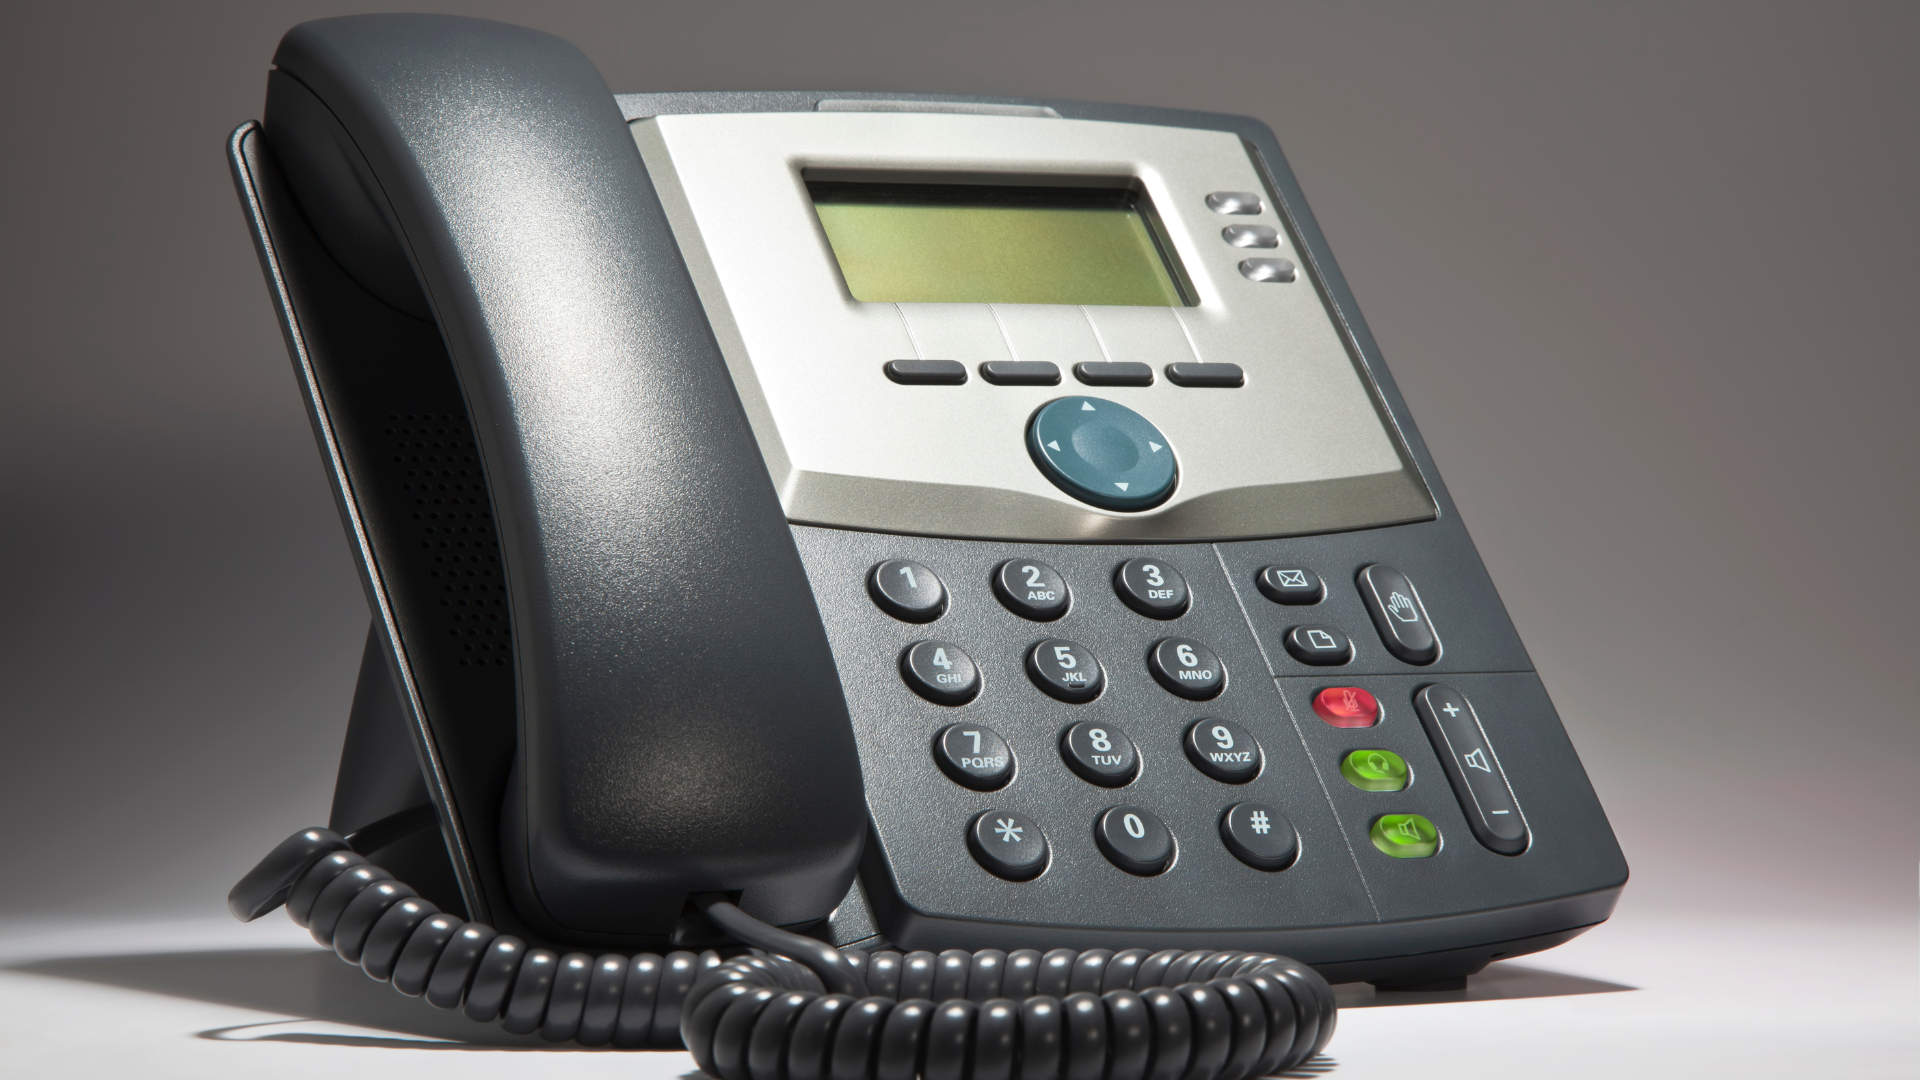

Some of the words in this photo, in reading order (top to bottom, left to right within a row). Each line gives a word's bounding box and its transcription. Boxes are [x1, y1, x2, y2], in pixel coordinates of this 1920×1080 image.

[900, 567, 919, 589] 1
[1022, 566, 1046, 588] 2
[1143, 565, 1165, 587] 3
[1027, 589, 1057, 602] ABC
[1147, 589, 1174, 599] DEF
[933, 648, 954, 670] 4
[1054, 647, 1077, 669] 5
[1177, 645, 1199, 668] 6
[935, 671, 963, 685] GHI
[1061, 671, 1088, 682] JKL
[1178, 669, 1213, 680] MNO
[963, 731, 981, 754] 7
[1089, 729, 1112, 752] 8
[1212, 726, 1234, 749] 9
[961, 756, 1006, 771] PQRS
[1091, 754, 1122, 766] TUV
[1209, 751, 1252, 763] WXYZ
[1124, 814, 1145, 839] 0
